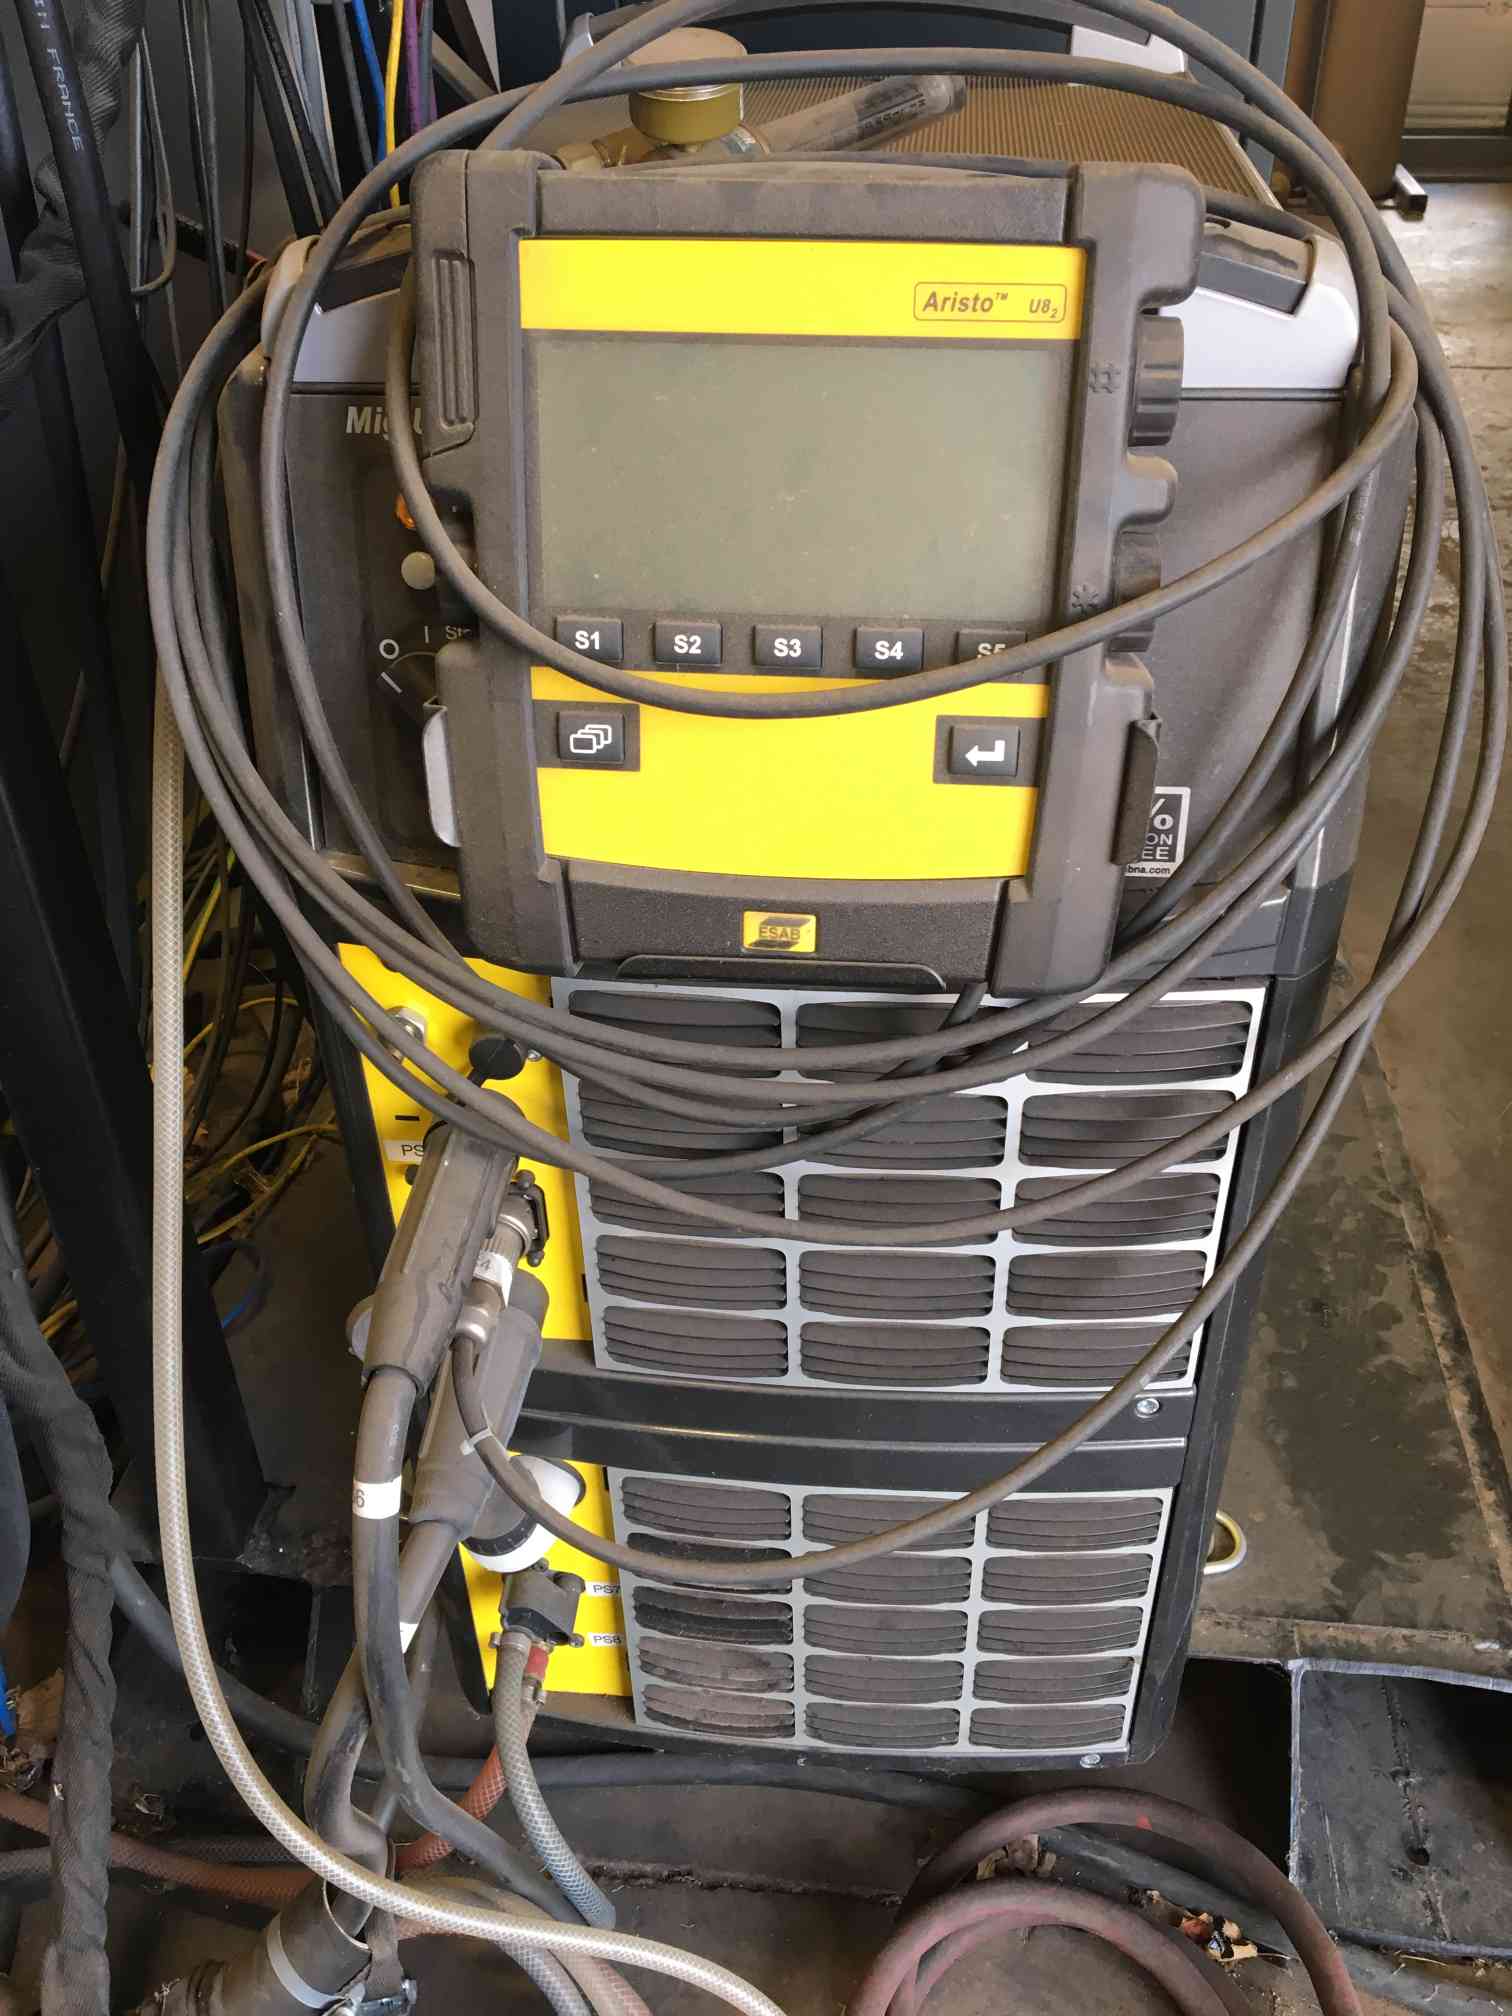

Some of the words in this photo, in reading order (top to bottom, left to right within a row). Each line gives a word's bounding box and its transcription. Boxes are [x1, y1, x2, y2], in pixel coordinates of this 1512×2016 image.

[47, 48, 85, 152] FRANCE
[345, 406, 389, 440] Mi
[575, 630, 601, 650] S1
[674, 634, 702, 654] S2
[773, 638, 802, 658] S3
[874, 640, 904, 660] S4
[1145, 832, 1173, 845] ON
[1142, 846, 1169, 860] EE
[1127, 865, 1170, 875] bna.com
[759, 926, 801, 941] ESAB
[401, 1143, 424, 1158] PS
